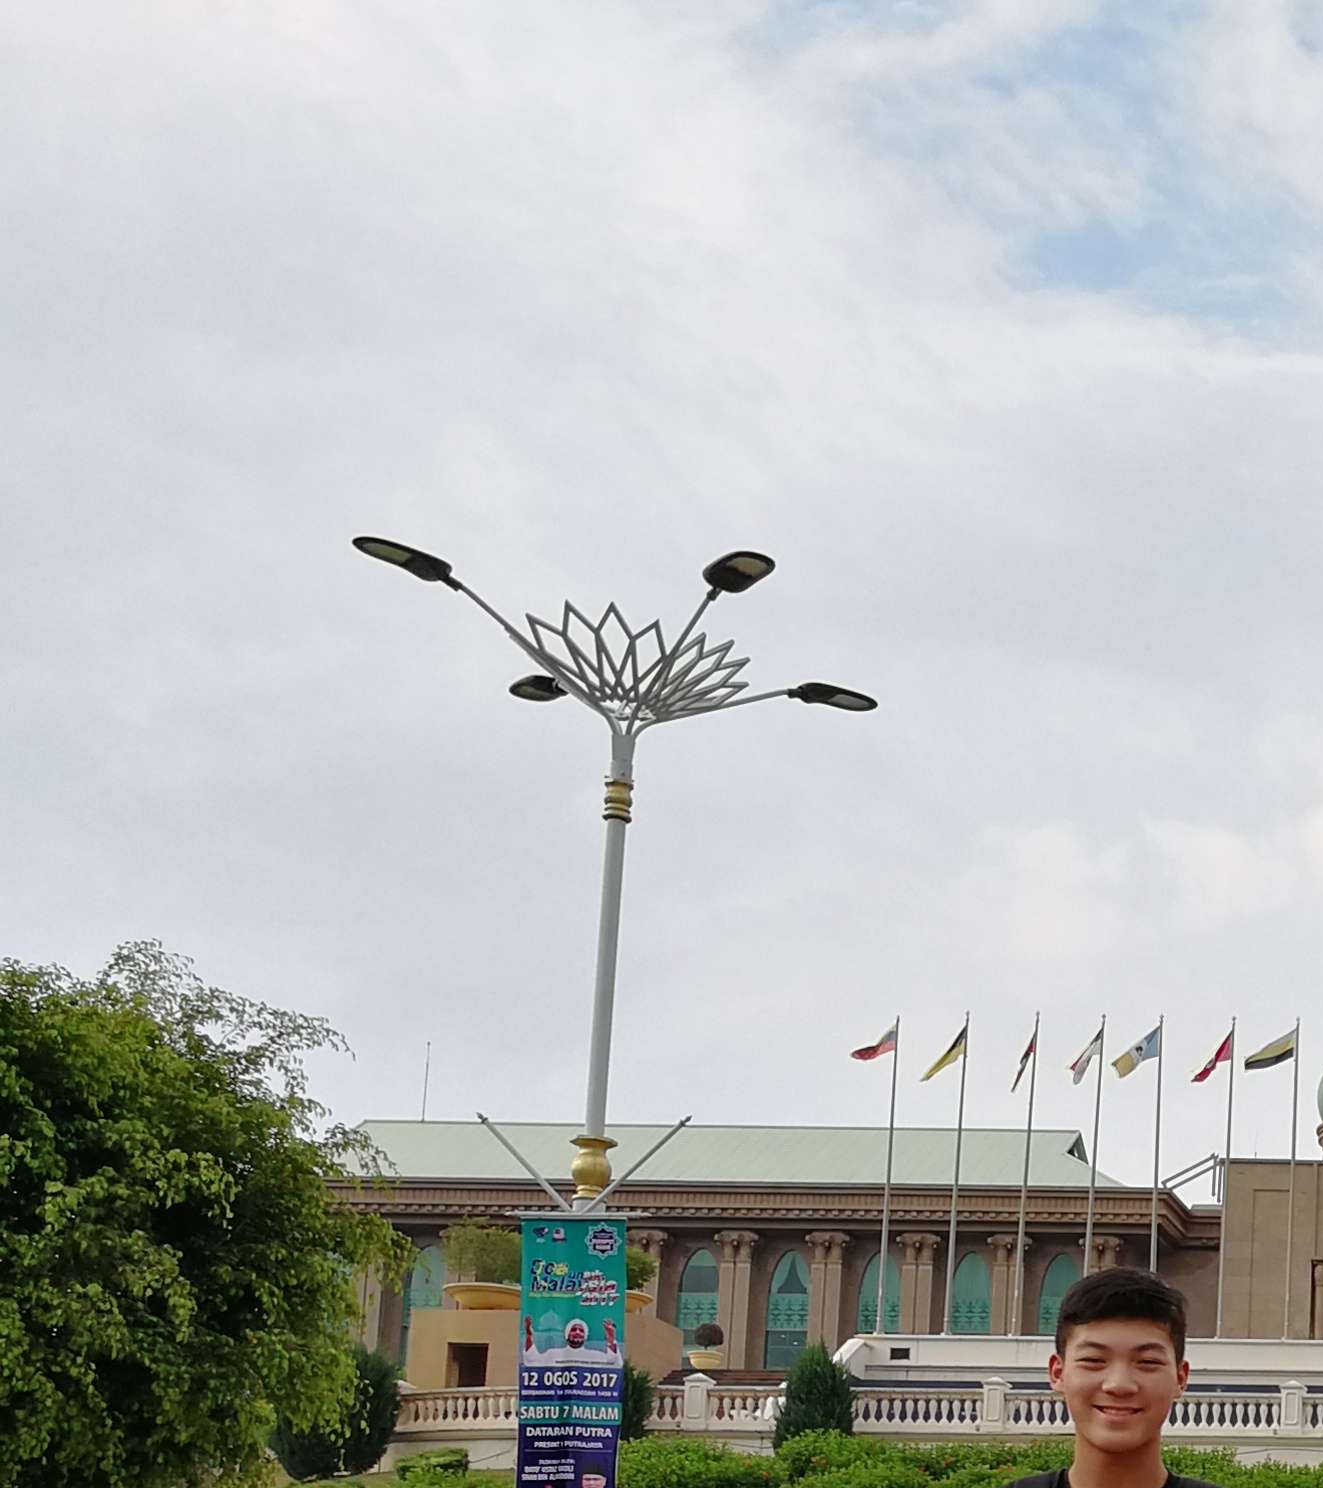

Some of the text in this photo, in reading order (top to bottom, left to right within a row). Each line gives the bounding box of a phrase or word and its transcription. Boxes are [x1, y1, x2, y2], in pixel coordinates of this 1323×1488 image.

[521, 1371, 618, 1388] 12 OGOS 2017
[520, 1405, 619, 1420] SABTU 7 MALAM
[526, 1427, 612, 1438] DATARAN PUTRA
